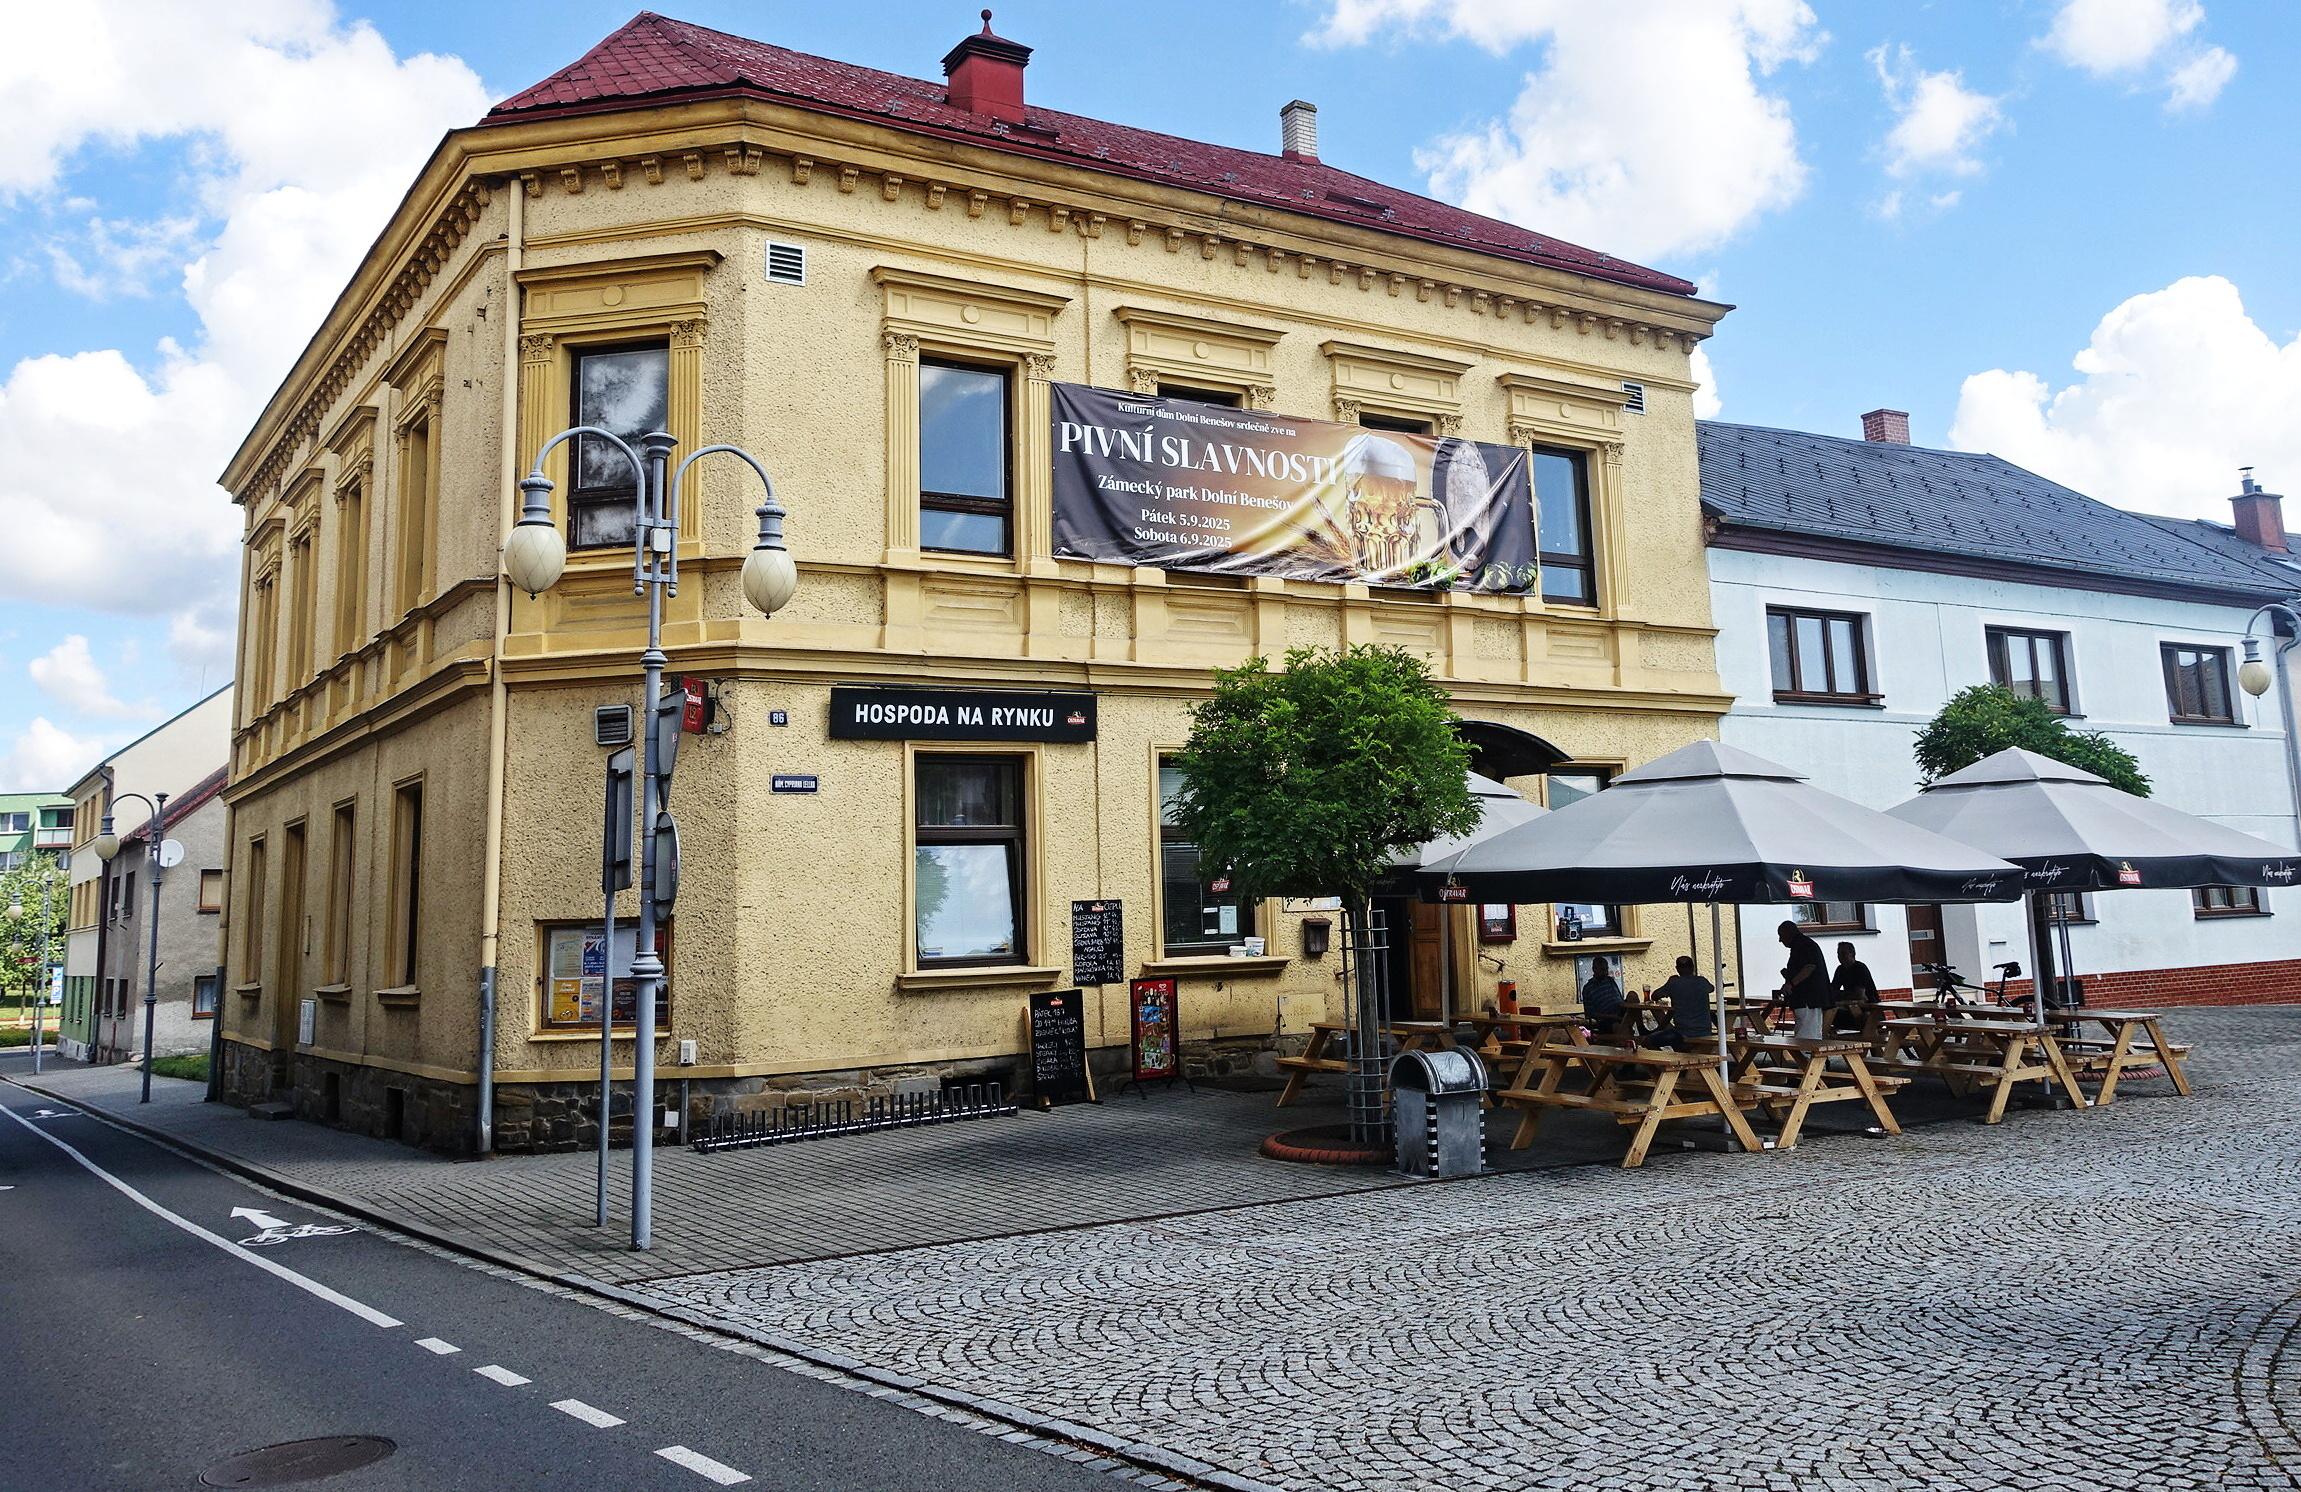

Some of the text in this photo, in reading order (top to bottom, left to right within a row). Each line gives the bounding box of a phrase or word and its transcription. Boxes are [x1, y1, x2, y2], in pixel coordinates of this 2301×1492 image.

[1117, 402, 1297, 437] Kulturní dům Dolní Benešov srdečně zve na
[1059, 421, 1337, 486] PIVNÍ SLAVNOSTI
[1098, 473, 1296, 512] Zámecký park Dolní Benešov
[1141, 508, 1231, 531] Pátek 5.9.2025
[1134, 526, 1233, 549] Sobota 6.9.2025
[772, 712, 785, 724] 86
[854, 703, 1055, 728] HOSPODA NA RYNKU
